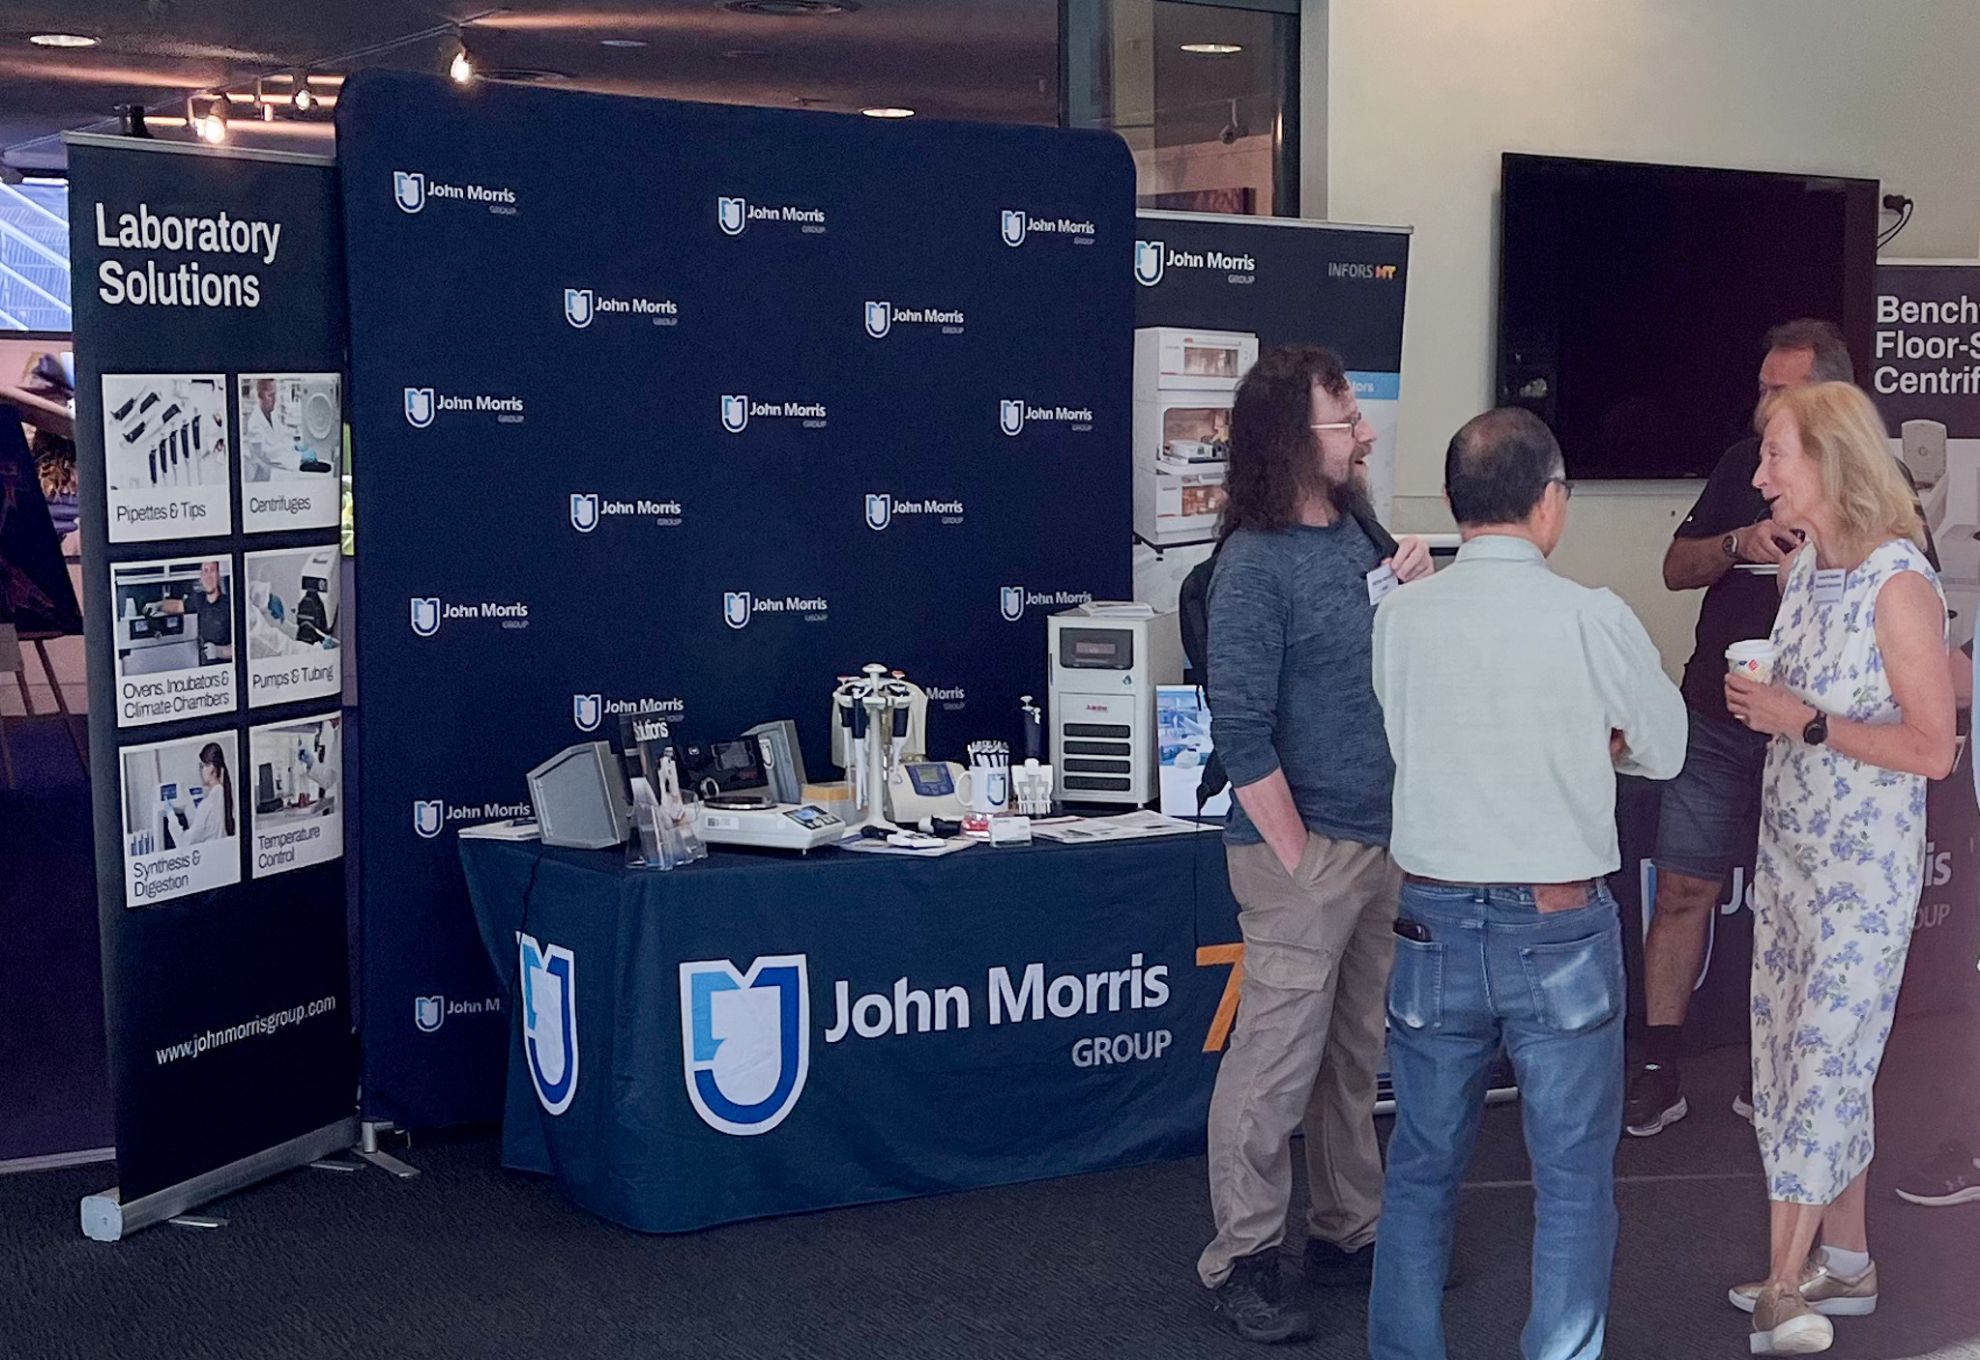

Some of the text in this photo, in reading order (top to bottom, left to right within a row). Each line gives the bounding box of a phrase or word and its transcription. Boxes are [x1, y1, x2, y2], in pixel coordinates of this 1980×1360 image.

[428, 182, 515, 203] John Morris
[748, 205, 824, 222] John Morris
[96, 203, 281, 264] Laboratory
[1027, 218, 1094, 234] John Morris
[1166, 250, 1254, 270] John Morris
[1329, 263, 1373, 278] INFORS
[99, 261, 259, 307] Solutions
[1228, 275, 1255, 284] GROUP
[595, 297, 677, 314] John Morris
[1876, 295, 1980, 324] Bench
[892, 309, 963, 323] John Morris
[437, 395, 523, 410] John Morris
[750, 402, 826, 417] John Morris
[1025, 404, 1092, 421] John Morris
[116, 502, 206, 524] Pipettes & Tips
[249, 495, 312, 514] Centrifuges
[601, 501, 681, 514] John Morris
[892, 500, 963, 513] John Morris
[753, 597, 827, 611] John Morris
[1026, 591, 1092, 604] John Morris
[443, 603, 527, 617] John Morris
[123, 670, 230, 699] Ovens, Incubators &
[252, 664, 334, 690] Pumps & Tubing
[925, 687, 964, 701] Morris
[124, 691, 230, 719] Climate Chambers
[604, 698, 684, 714] John Morris
[446, 802, 530, 819] John Morris
[257, 825, 321, 850] Temperature
[133, 850, 201, 881] Synthesis &
[258, 846, 296, 869] Control
[134, 872, 190, 899] Digestion
[825, 943, 1245, 1053] John Morris 7
[447, 1001, 481, 1014] John
[155, 994, 336, 1065] www.johnmorrisgroup.com
[1072, 1030, 1172, 1067] GROUP
